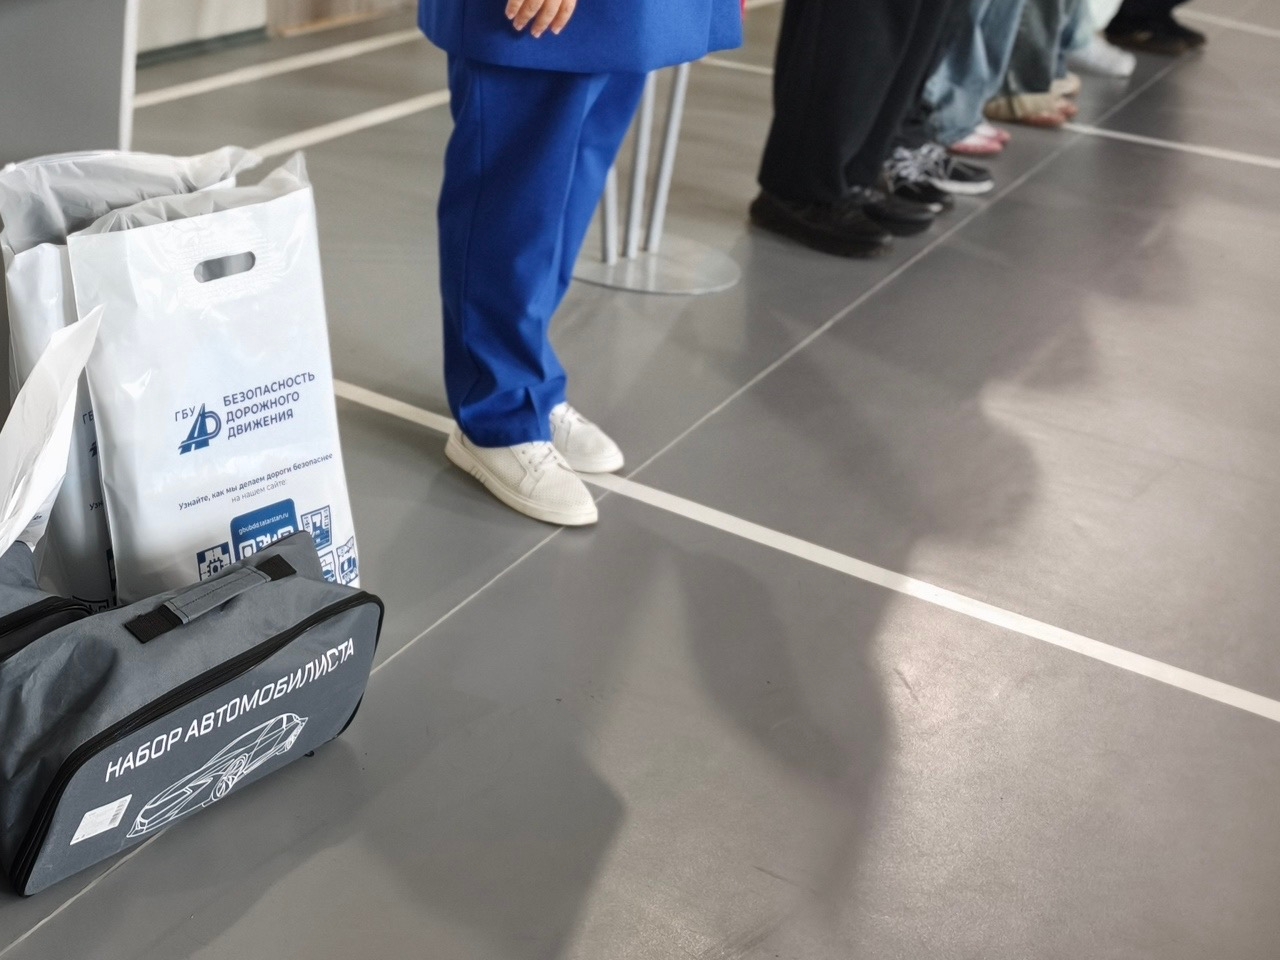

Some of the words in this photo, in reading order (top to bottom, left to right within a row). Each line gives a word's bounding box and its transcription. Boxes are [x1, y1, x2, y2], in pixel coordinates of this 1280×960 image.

[223, 371, 315, 407] БЕЗОПАСНОСТЬ
[82, 410, 94, 424] ГБ
[174, 406, 196, 422] ГБУ
[226, 391, 300, 424] ДОРОЖНОГО
[228, 408, 294, 440] ДВИЖЕНИЯ
[179, 495, 210, 510] Узнайте,
[212, 490, 225, 499] как
[226, 485, 238, 493] мы
[239, 476, 265, 490] делаем
[266, 467, 292, 481] дороги
[293, 453, 333, 471] безопаснее
[242, 487, 265, 499] нашем
[105, 727, 182, 783] НАБОР
[184, 637, 355, 743] АВТОМОБИЛИСТА
